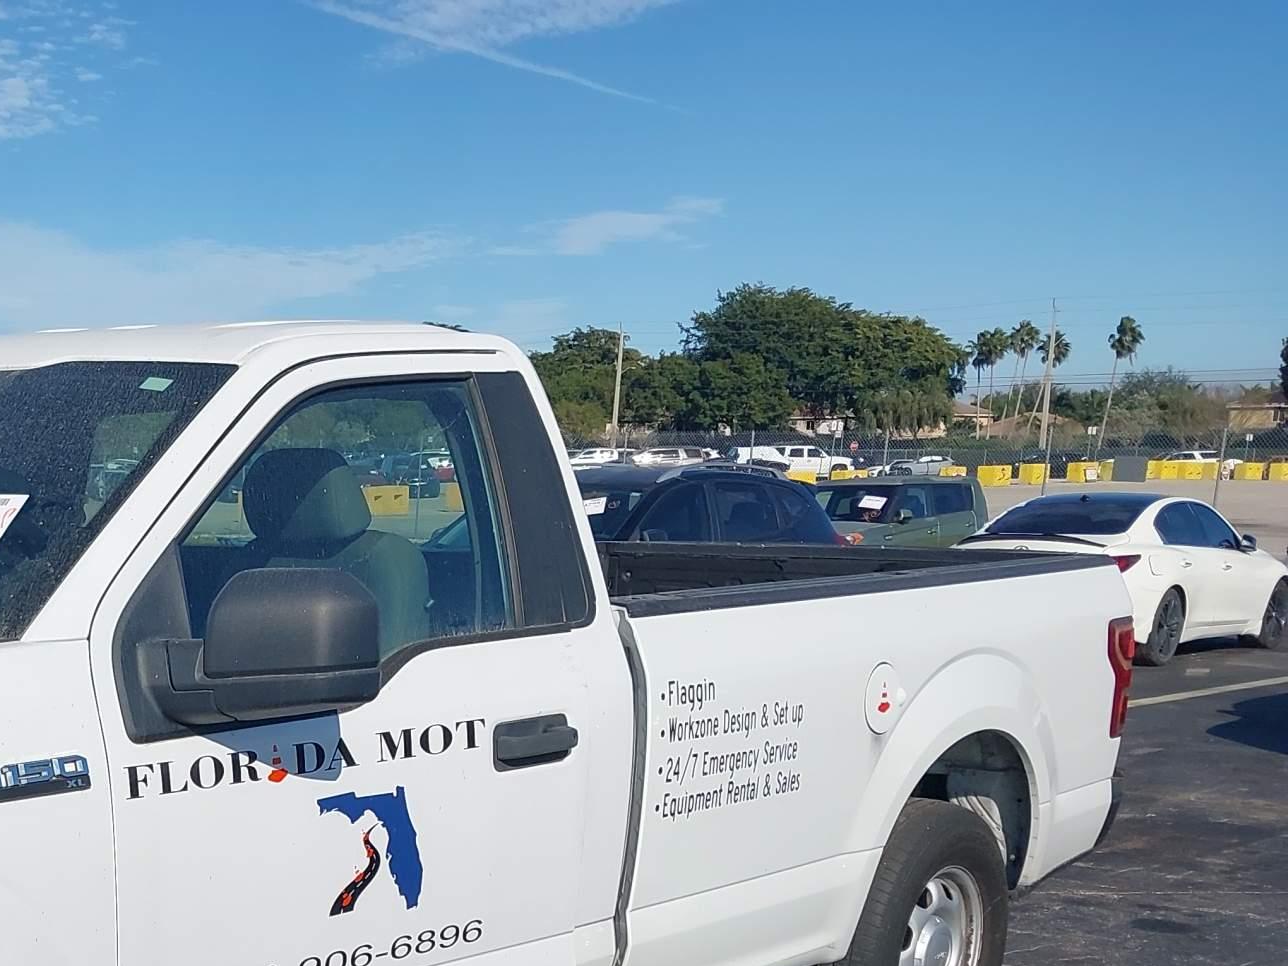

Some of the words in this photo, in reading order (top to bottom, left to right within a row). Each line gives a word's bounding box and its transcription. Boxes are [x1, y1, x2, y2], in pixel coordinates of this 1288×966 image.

[668, 679, 715, 711] Flaggin
[376, 719, 486, 763] MOT
[669, 715, 719, 743] Workzone
[723, 708, 757, 737] Design
[761, 704, 769, 727] &
[773, 702, 789, 725] Set
[792, 703, 804, 727] up
[666, 747, 698, 786] 24/7
[702, 747, 759, 779] Emergency
[763, 738, 798, 766] Service
[662, 784, 722, 822] Equipment
[726, 776, 759, 805] Rental
[763, 774, 771, 797] &
[775, 770, 801, 795] Sales
